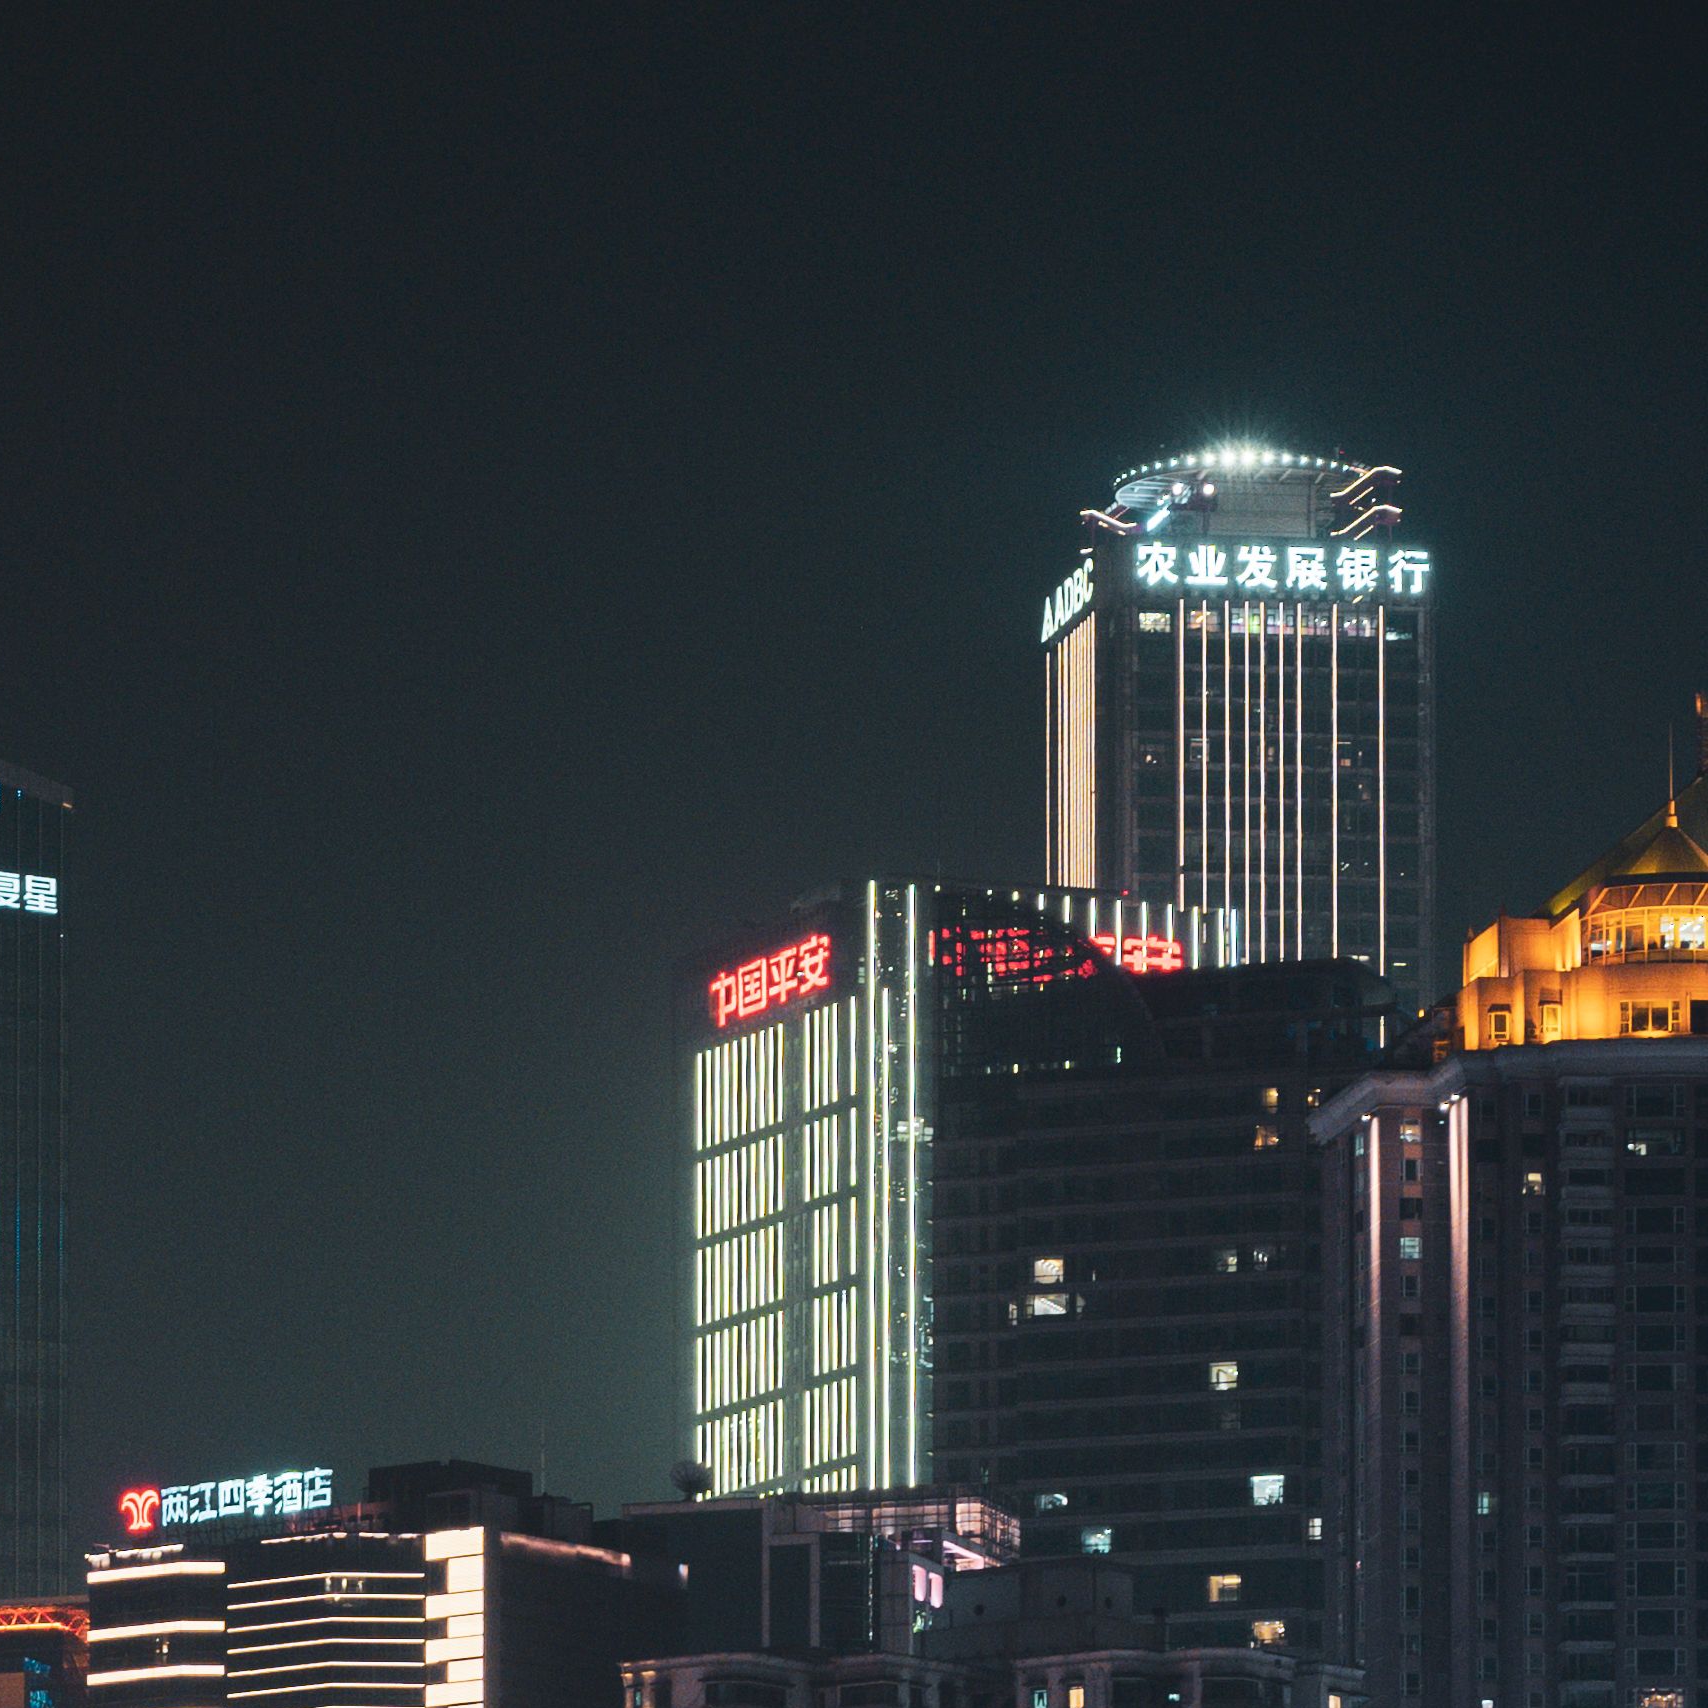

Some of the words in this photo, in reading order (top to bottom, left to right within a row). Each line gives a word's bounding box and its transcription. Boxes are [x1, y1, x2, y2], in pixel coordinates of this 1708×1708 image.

[1136, 541, 1431, 595] 农业发展银行
[709, 933, 832, 1028] 中国平安
[160, 1467, 334, 1527] 两江四季酒店
